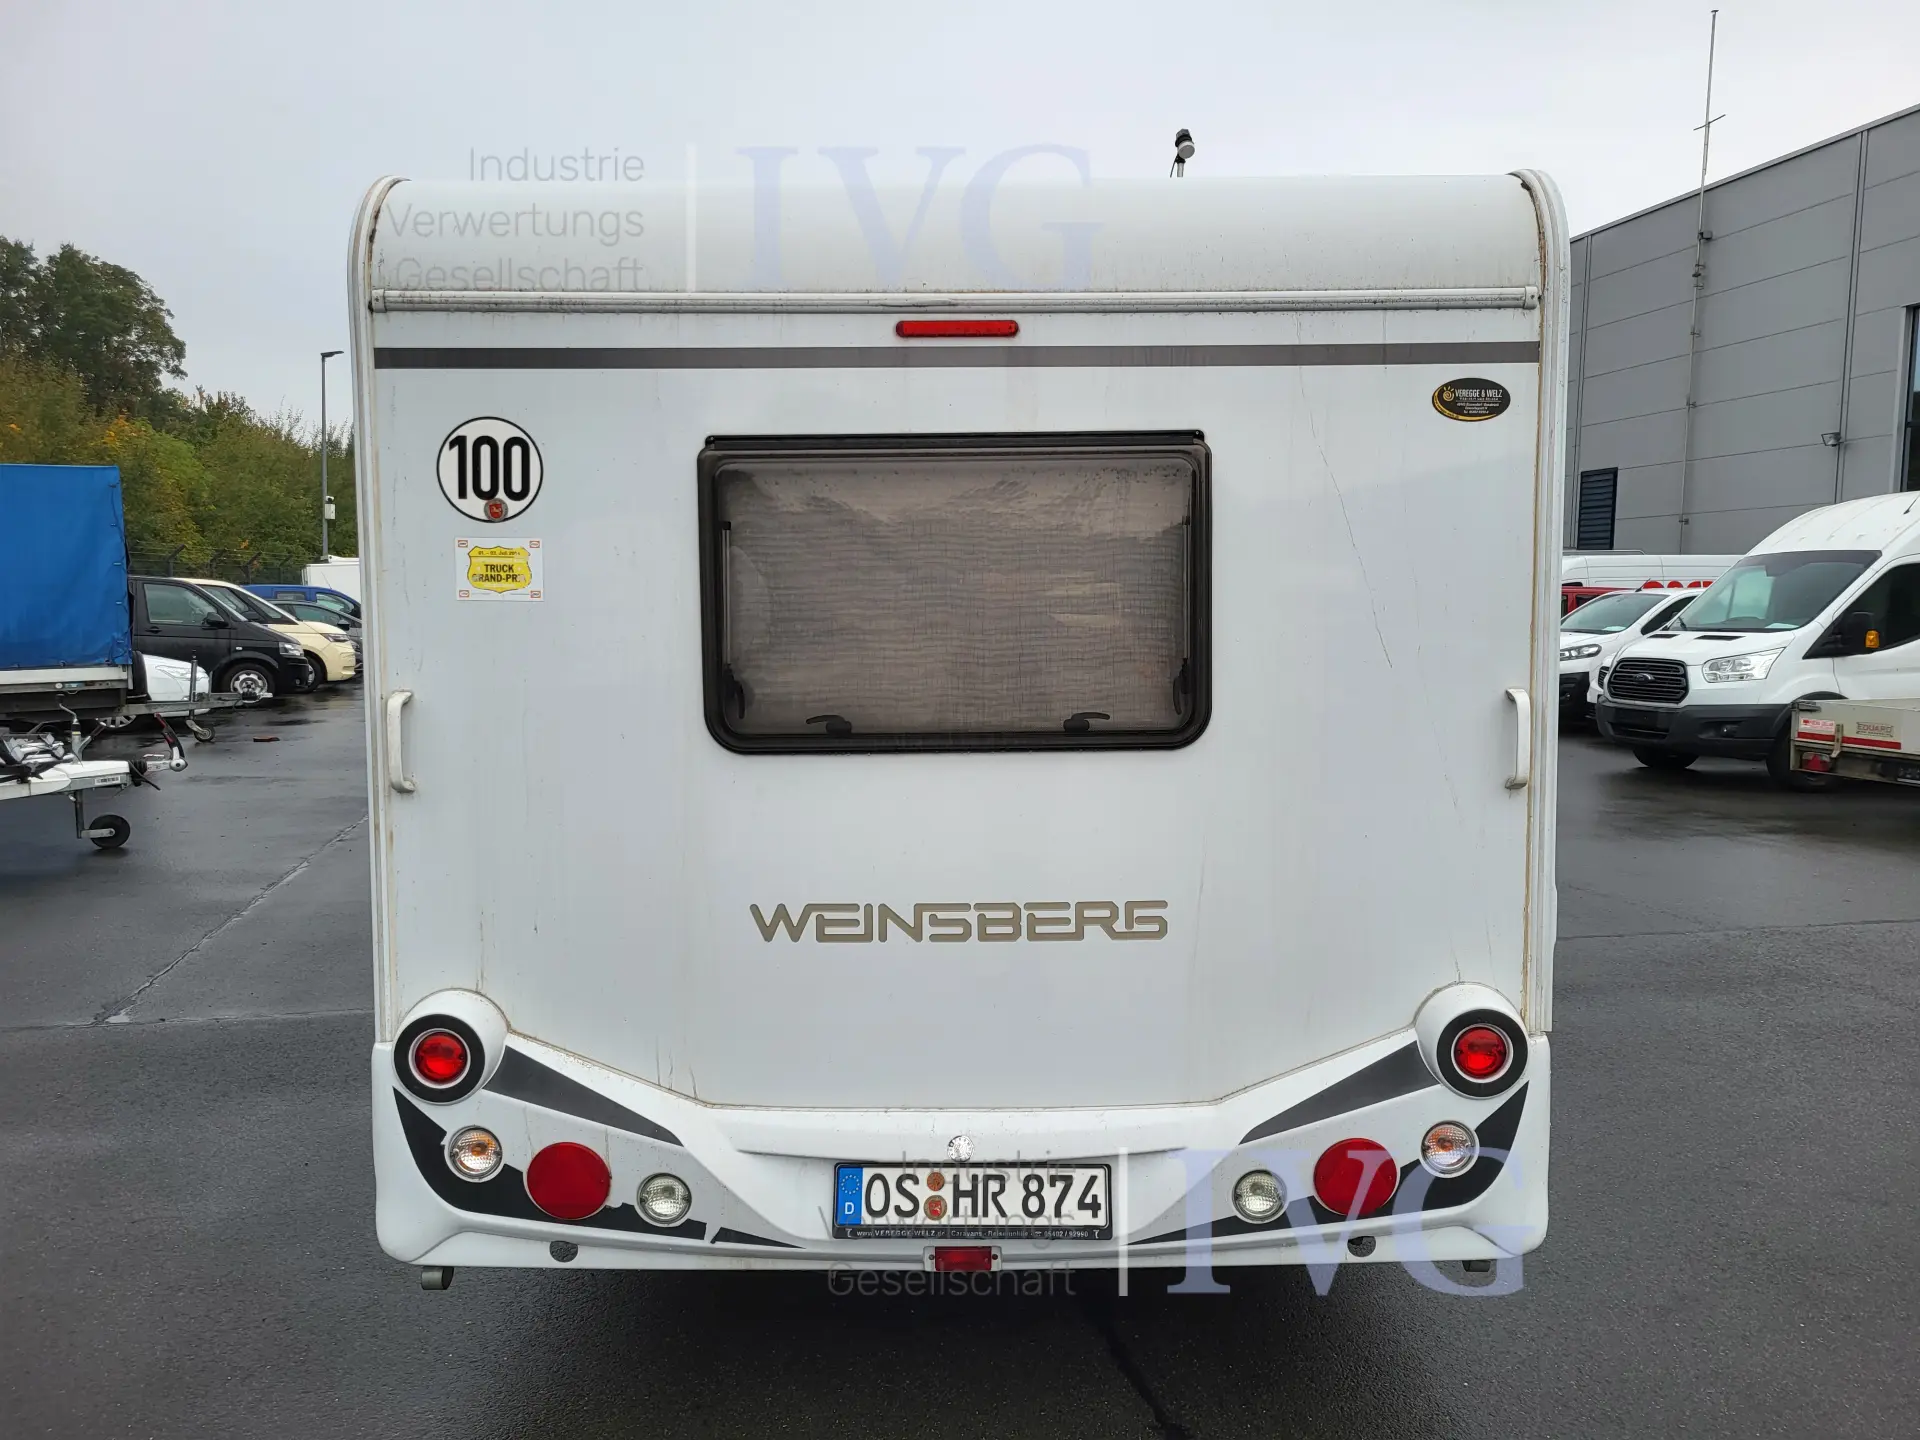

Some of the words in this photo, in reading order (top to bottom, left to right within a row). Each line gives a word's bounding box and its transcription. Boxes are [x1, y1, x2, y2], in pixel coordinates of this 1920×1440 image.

[1487, 389, 1503, 398] WELZ
[449, 435, 531, 502] 100
[484, 563, 514, 573] TRUCK
[749, 900, 1169, 943] WEINSBERG
[844, 1201, 854, 1215] D
[864, 1173, 920, 1218] OS
[952, 1174, 1008, 1218] HR
[1021, 1175, 1101, 1219] 874
